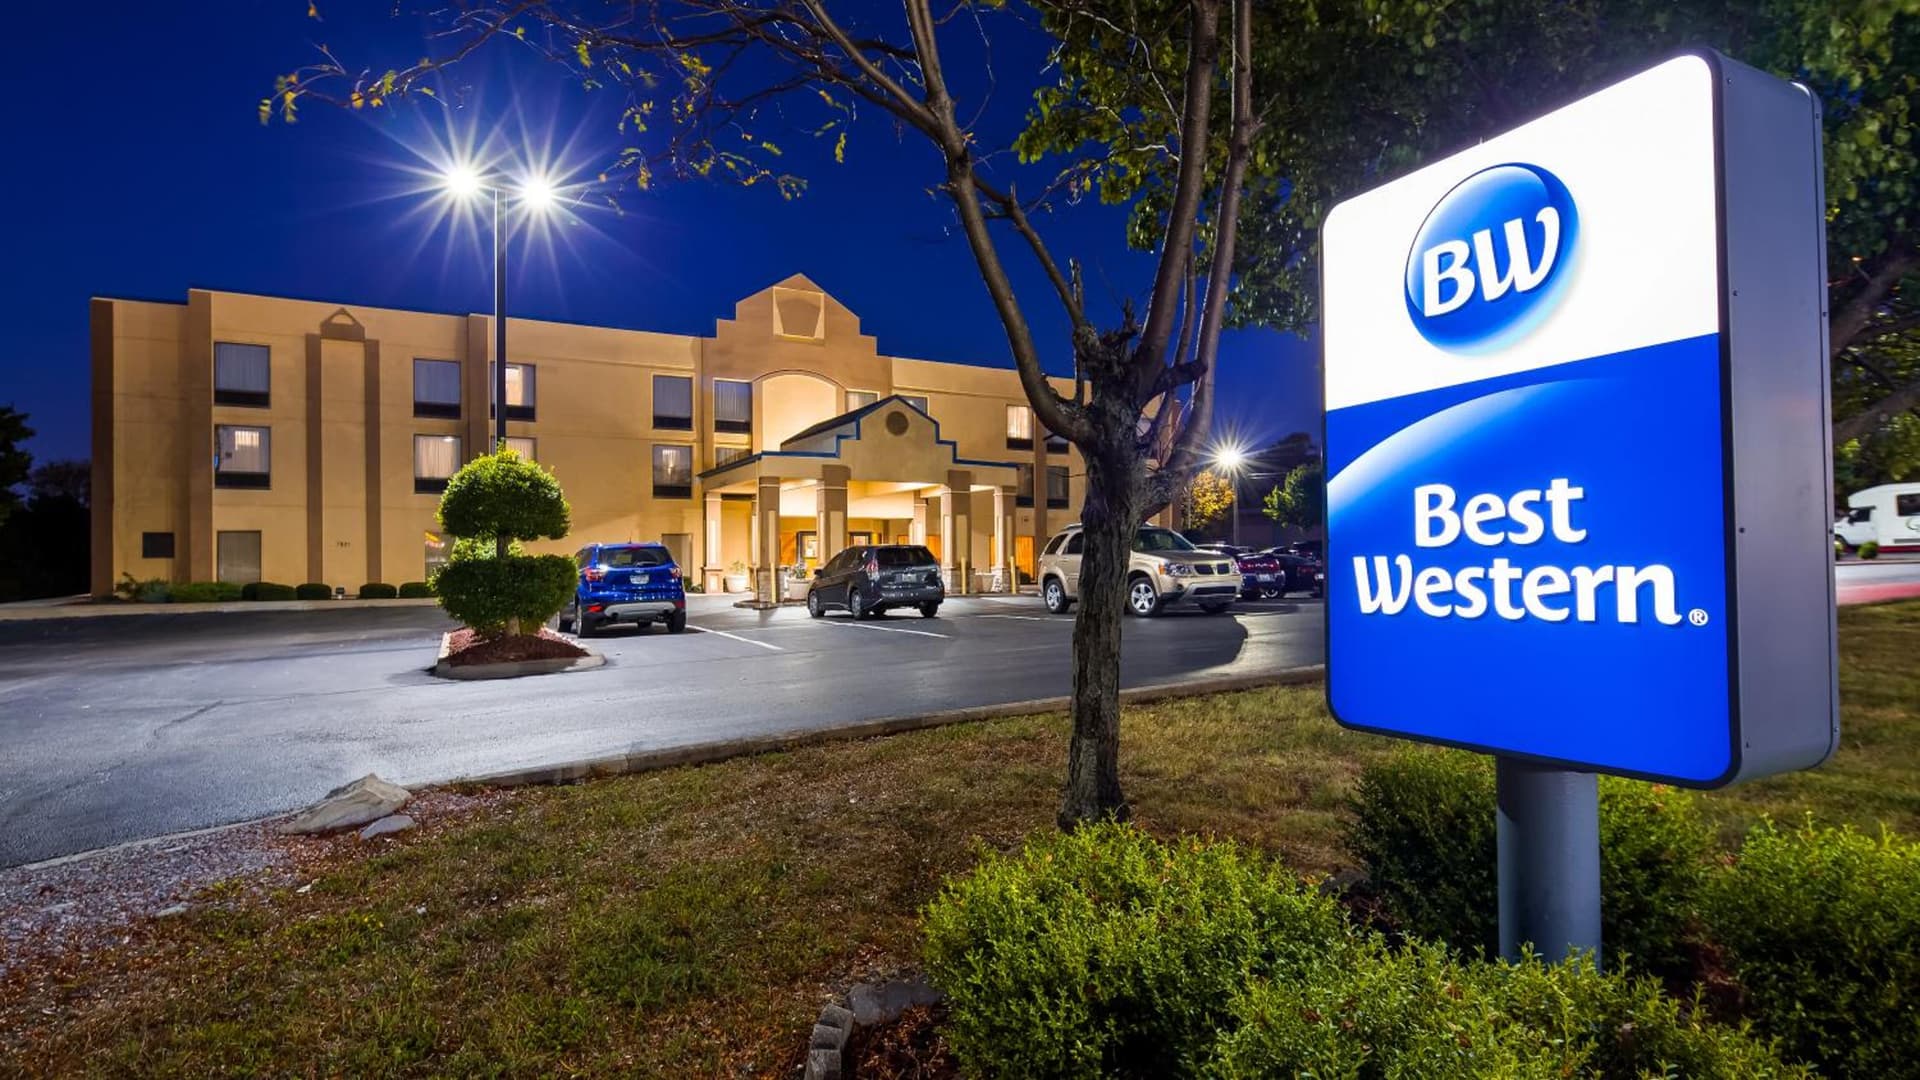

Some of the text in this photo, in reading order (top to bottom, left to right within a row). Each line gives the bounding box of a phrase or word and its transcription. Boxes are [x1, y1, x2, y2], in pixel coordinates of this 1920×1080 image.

[1424, 206, 1560, 317] BW
[1414, 478, 1587, 548] Best
[1352, 554, 1683, 626] Western
